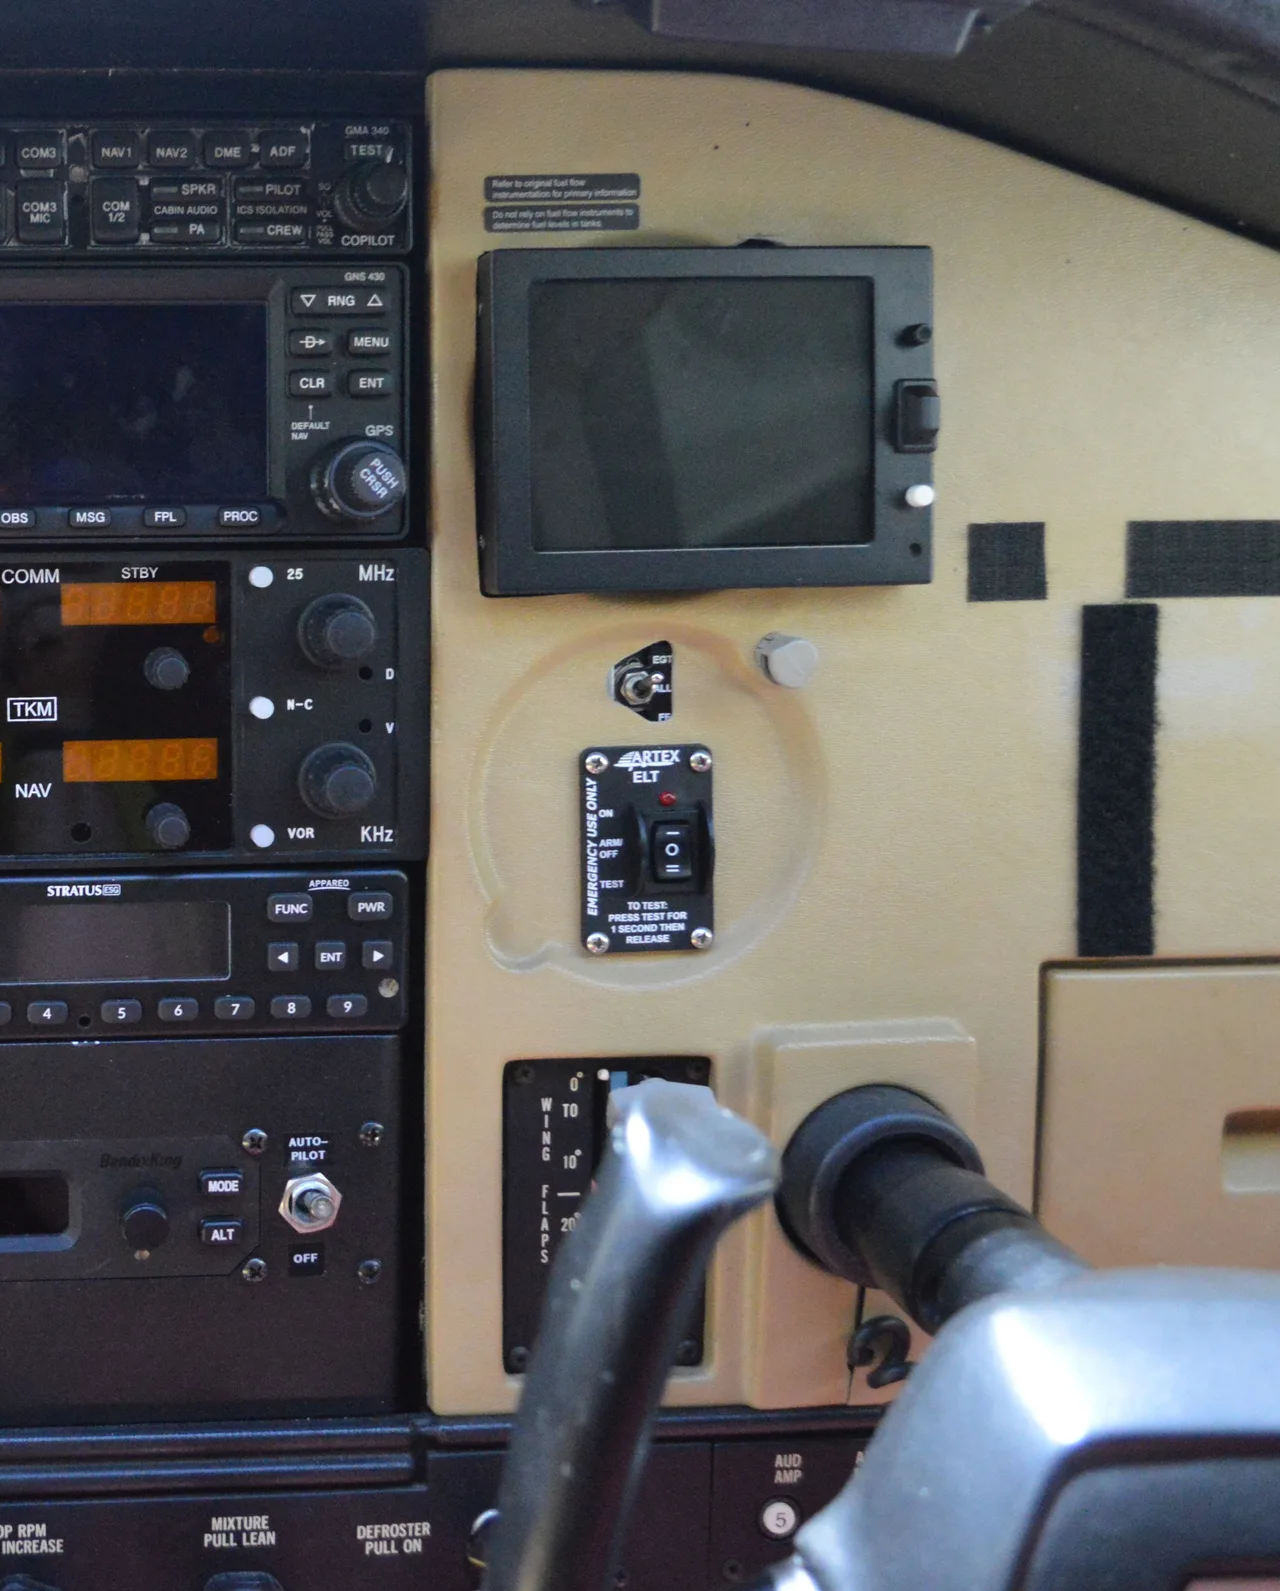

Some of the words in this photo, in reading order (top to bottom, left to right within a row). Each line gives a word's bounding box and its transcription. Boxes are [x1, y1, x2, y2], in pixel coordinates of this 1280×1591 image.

[22, 147, 56, 159] COM3
[101, 147, 132, 157] NAV1
[156, 147, 188, 158] NAV2
[214, 147, 241, 157] DME
[270, 146, 296, 157] ADF
[182, 184, 215, 195] SPKR
[492, 180, 512, 188] Refer
[154, 205, 184, 215] CABIN
[187, 205, 218, 215] AUDIO
[267, 225, 302, 235] CREW
[341, 235, 395, 246] COPILOT
[328, 296, 355, 306] RNG
[354, 337, 389, 348] MENU
[299, 378, 325, 389] CLR
[359, 378, 384, 388] ENT
[365, 425, 394, 437] GPS
[1, 512, 28, 524] OBS
[76, 512, 105, 523] MSG
[154, 511, 177, 522] FPL
[224, 510, 258, 522] PROC
[1, 569, 60, 584] COMM
[121, 567, 158, 579] STBY
[358, 565, 395, 581] MHz
[13, 701, 52, 717] TKM
[631, 750, 680, 763] ARTEX
[632, 771, 660, 783] ELT
[15, 783, 52, 799] NAV
[586, 778, 598, 810] ONLY
[587, 808, 598, 838] USE
[287, 827, 314, 839] VOR
[360, 826, 393, 842] KHz
[599, 850, 619, 858] OFF
[587, 840, 598, 916] EMERGENCY
[308, 880, 349, 888] APPAREO
[600, 880, 624, 888] TEST
[47, 885, 120, 896] STRATUS
[275, 903, 308, 915] FUNC
[357, 902, 385, 913] PWR
[608, 913, 640, 922] PRESS
[642, 912, 666, 921] TEST
[667, 912, 687, 920] FOR
[618, 924, 657, 933] SECOND
[659, 923, 685, 932] THEN
[626, 935, 669, 944] RELEASE
[320, 952, 342, 963] ENT
[562, 1104, 578, 1118] TO
[291, 1151, 326, 1161] PILOT
[208, 1180, 239, 1192] MODE
[211, 1229, 234, 1240] ALT
[293, 1253, 318, 1264] OFF
[775, 1454, 802, 1467] AUD
[774, 1470, 802, 1483] AMP
[211, 1516, 269, 1531] MIXTURE
[17, 1524, 47, 1539] RPM
[356, 1522, 430, 1539] DEFROSTER
[203, 1532, 238, 1547] PULL
[243, 1531, 276, 1546] LEAN
[1, 1539, 63, 1554] INCREASE
[365, 1540, 398, 1554] PULL
[403, 1539, 422, 1553] ON
